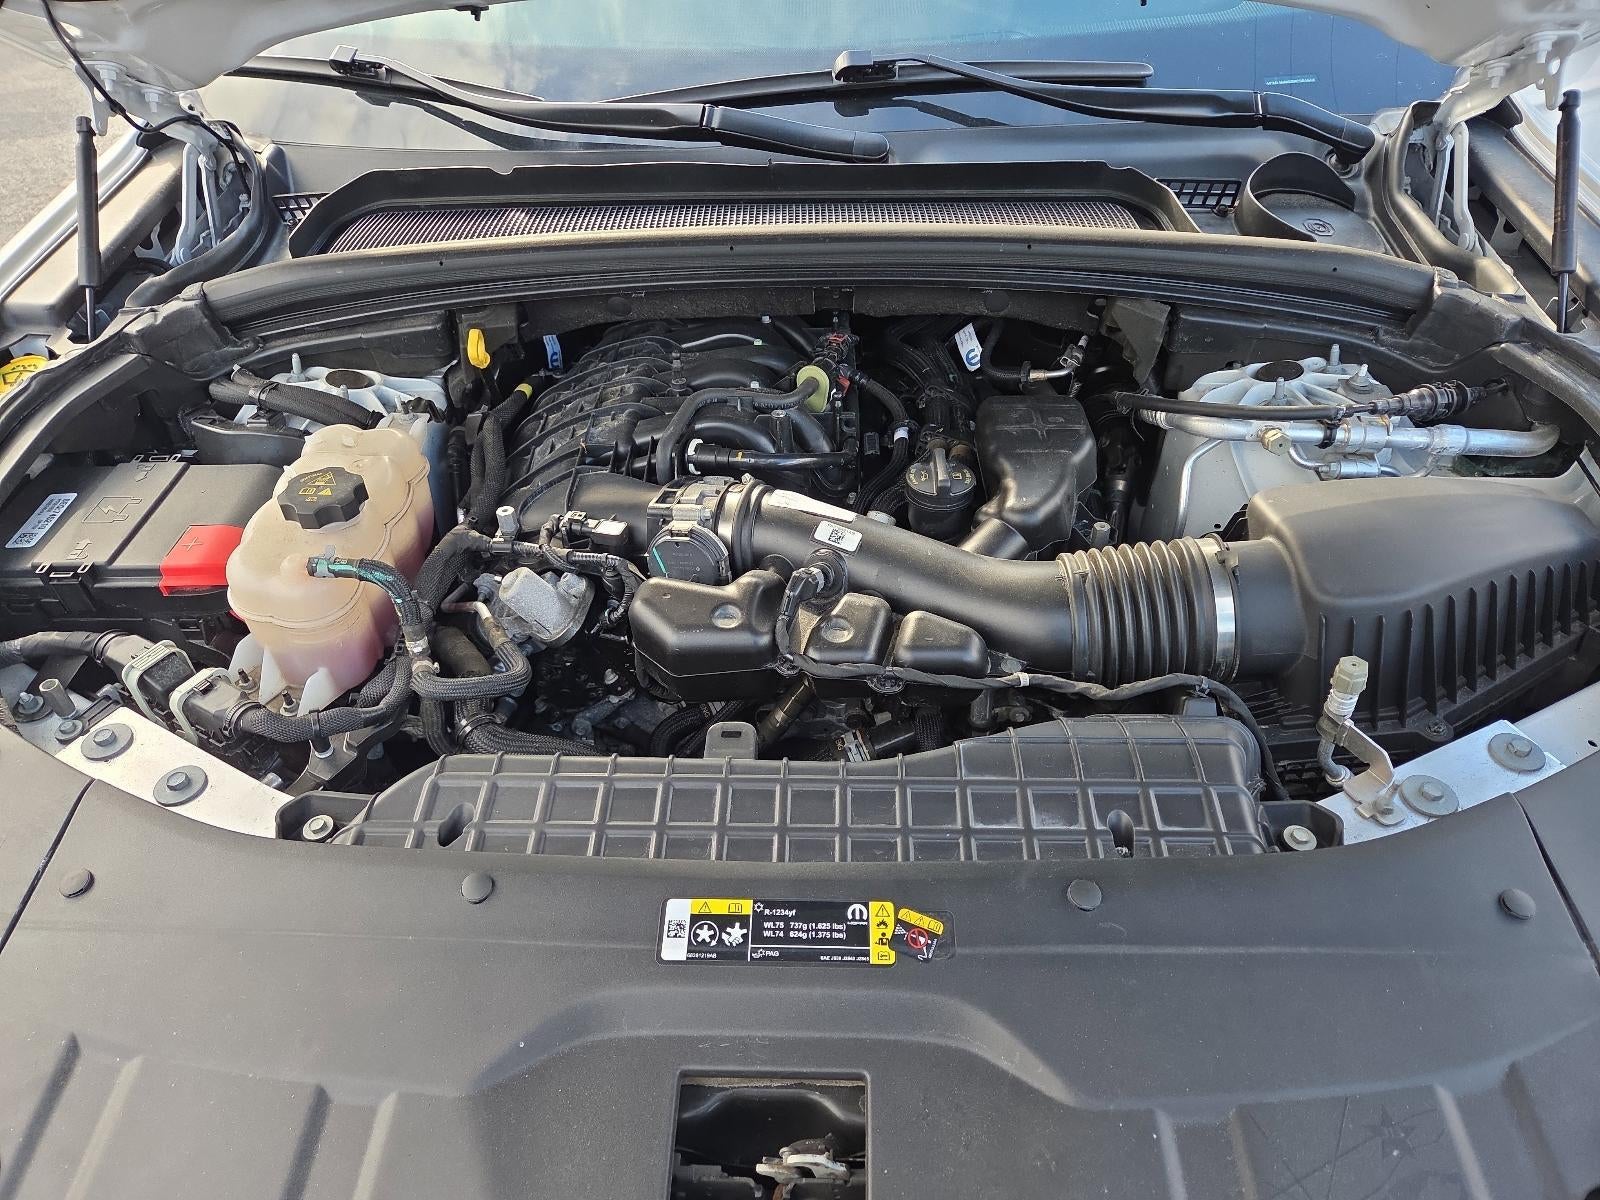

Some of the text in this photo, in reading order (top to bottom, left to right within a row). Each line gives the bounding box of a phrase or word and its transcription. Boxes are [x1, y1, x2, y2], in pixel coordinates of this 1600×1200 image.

[764, 909, 796, 917] R-1234yf
[763, 921, 846, 931] WL75 737g (1.625 lbs)
[763, 930, 784, 938] WL74
[809, 931, 831, 940] (1.375
[832, 931, 846, 940] lbs)
